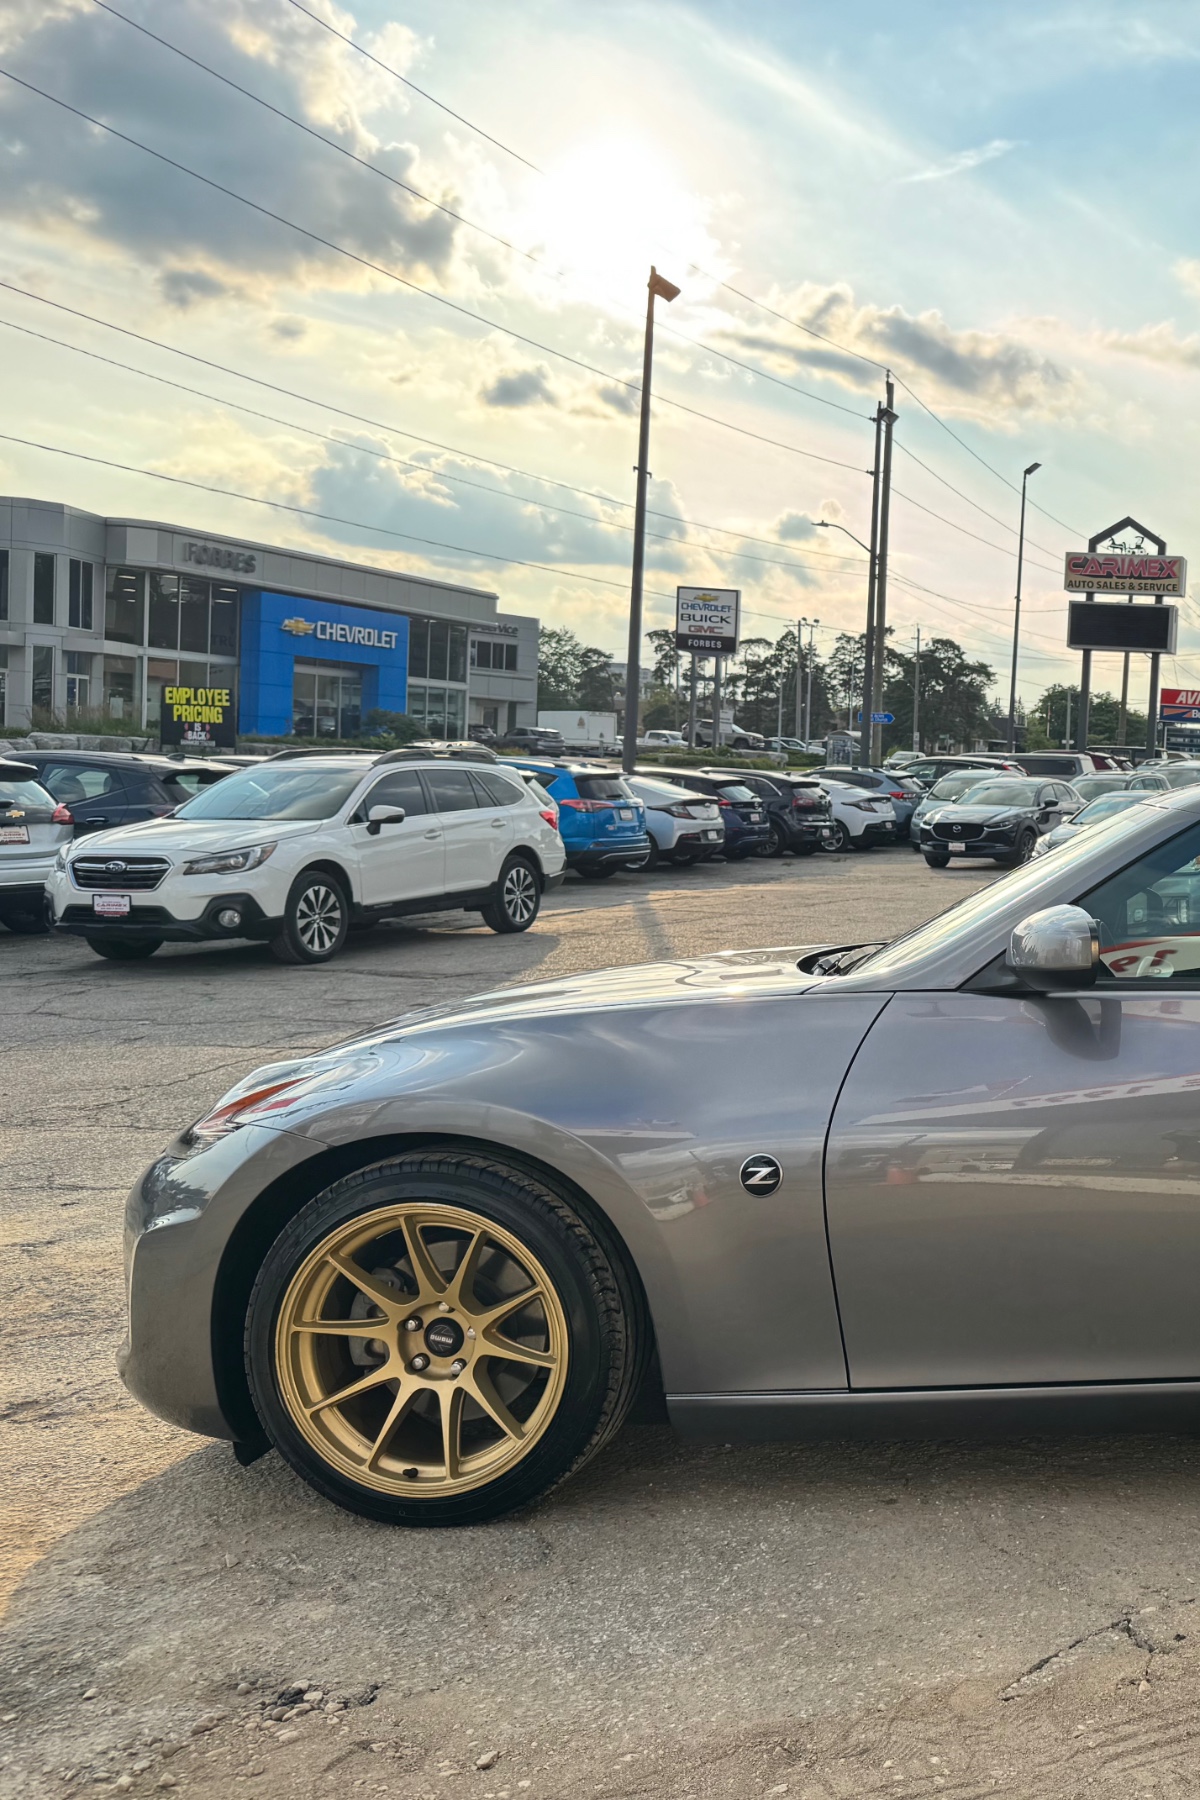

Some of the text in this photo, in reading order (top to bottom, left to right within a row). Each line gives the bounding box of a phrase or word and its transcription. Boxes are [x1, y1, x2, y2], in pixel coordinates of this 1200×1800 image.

[183, 541, 256, 574] FORBES
[1067, 556, 1179, 578] CARIMEX
[1067, 579, 1178, 592] AUTO SALES & SERVICE
[681, 602, 732, 613] CHEVROLET
[680, 613, 732, 625] BUICK
[316, 620, 398, 649] CHEVROLET
[688, 625, 723, 635] GMC
[688, 639, 722, 648] FORBES
[165, 686, 231, 707] EMPLOYEE
[173, 704, 223, 723] PRICING
[194, 722, 202, 731] IS
[187, 730, 206, 740] BACK
